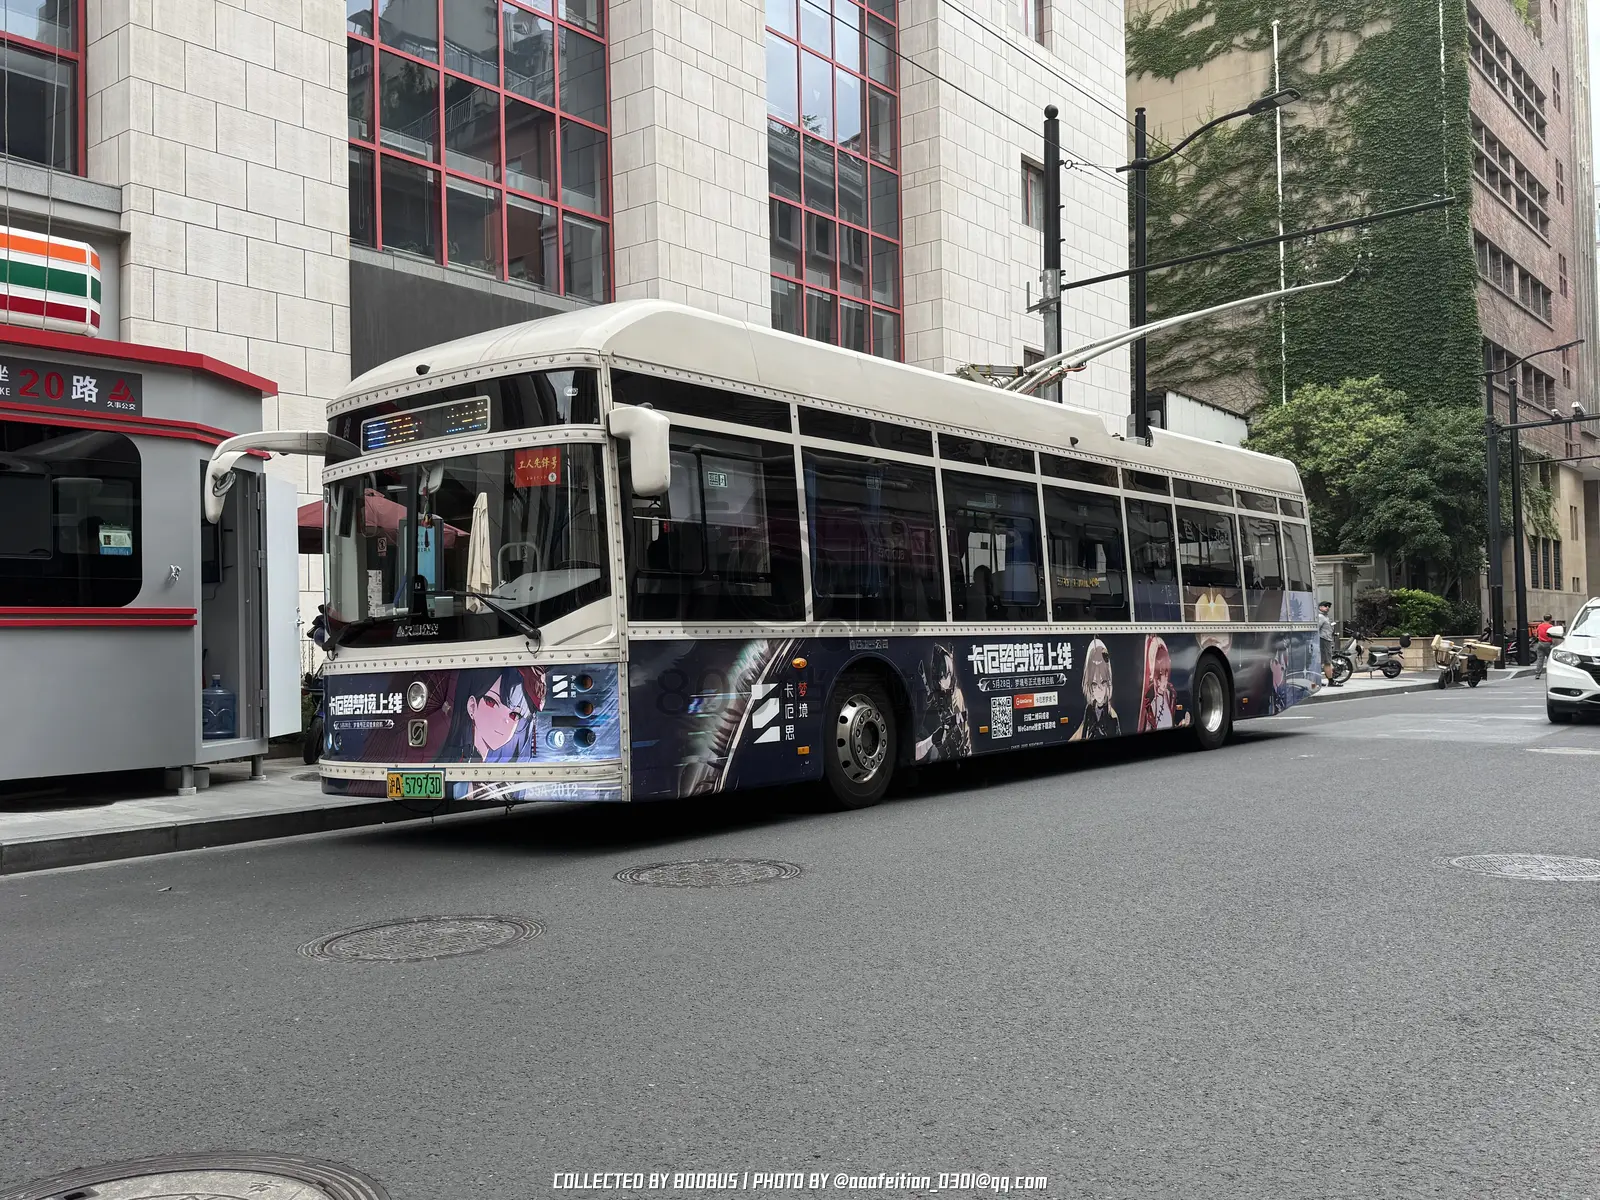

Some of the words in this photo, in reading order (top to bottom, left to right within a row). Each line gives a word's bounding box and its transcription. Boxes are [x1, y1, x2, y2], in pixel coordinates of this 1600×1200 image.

[107, 400, 136, 411] 久事公交
[517, 456, 558, 470] 工人先锋号
[783, 682, 795, 741] 卡厄思
[797, 681, 808, 718] 梦境
